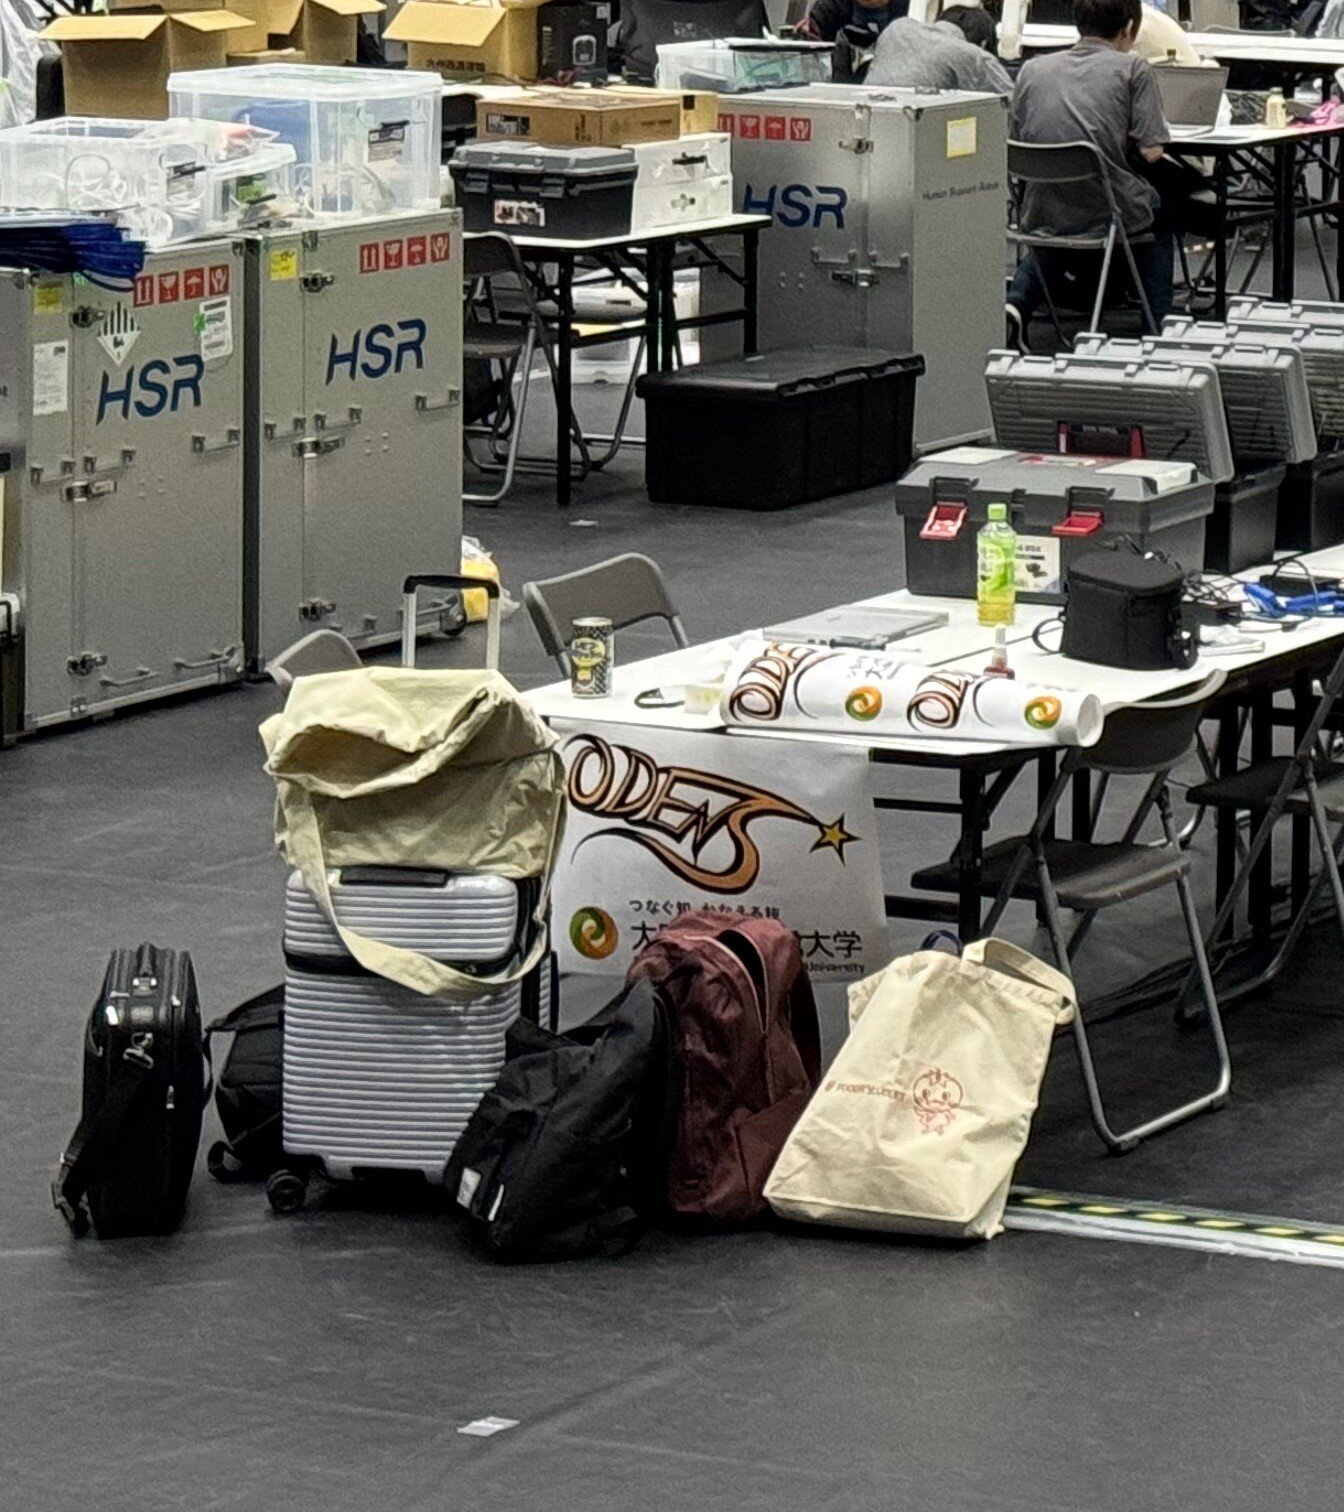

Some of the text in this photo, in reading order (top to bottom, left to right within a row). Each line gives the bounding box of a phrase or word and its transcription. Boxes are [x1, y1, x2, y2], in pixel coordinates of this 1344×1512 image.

[743, 183, 848, 229] HSR
[323, 318, 427, 387] HSR
[96, 353, 205, 426] HSR
